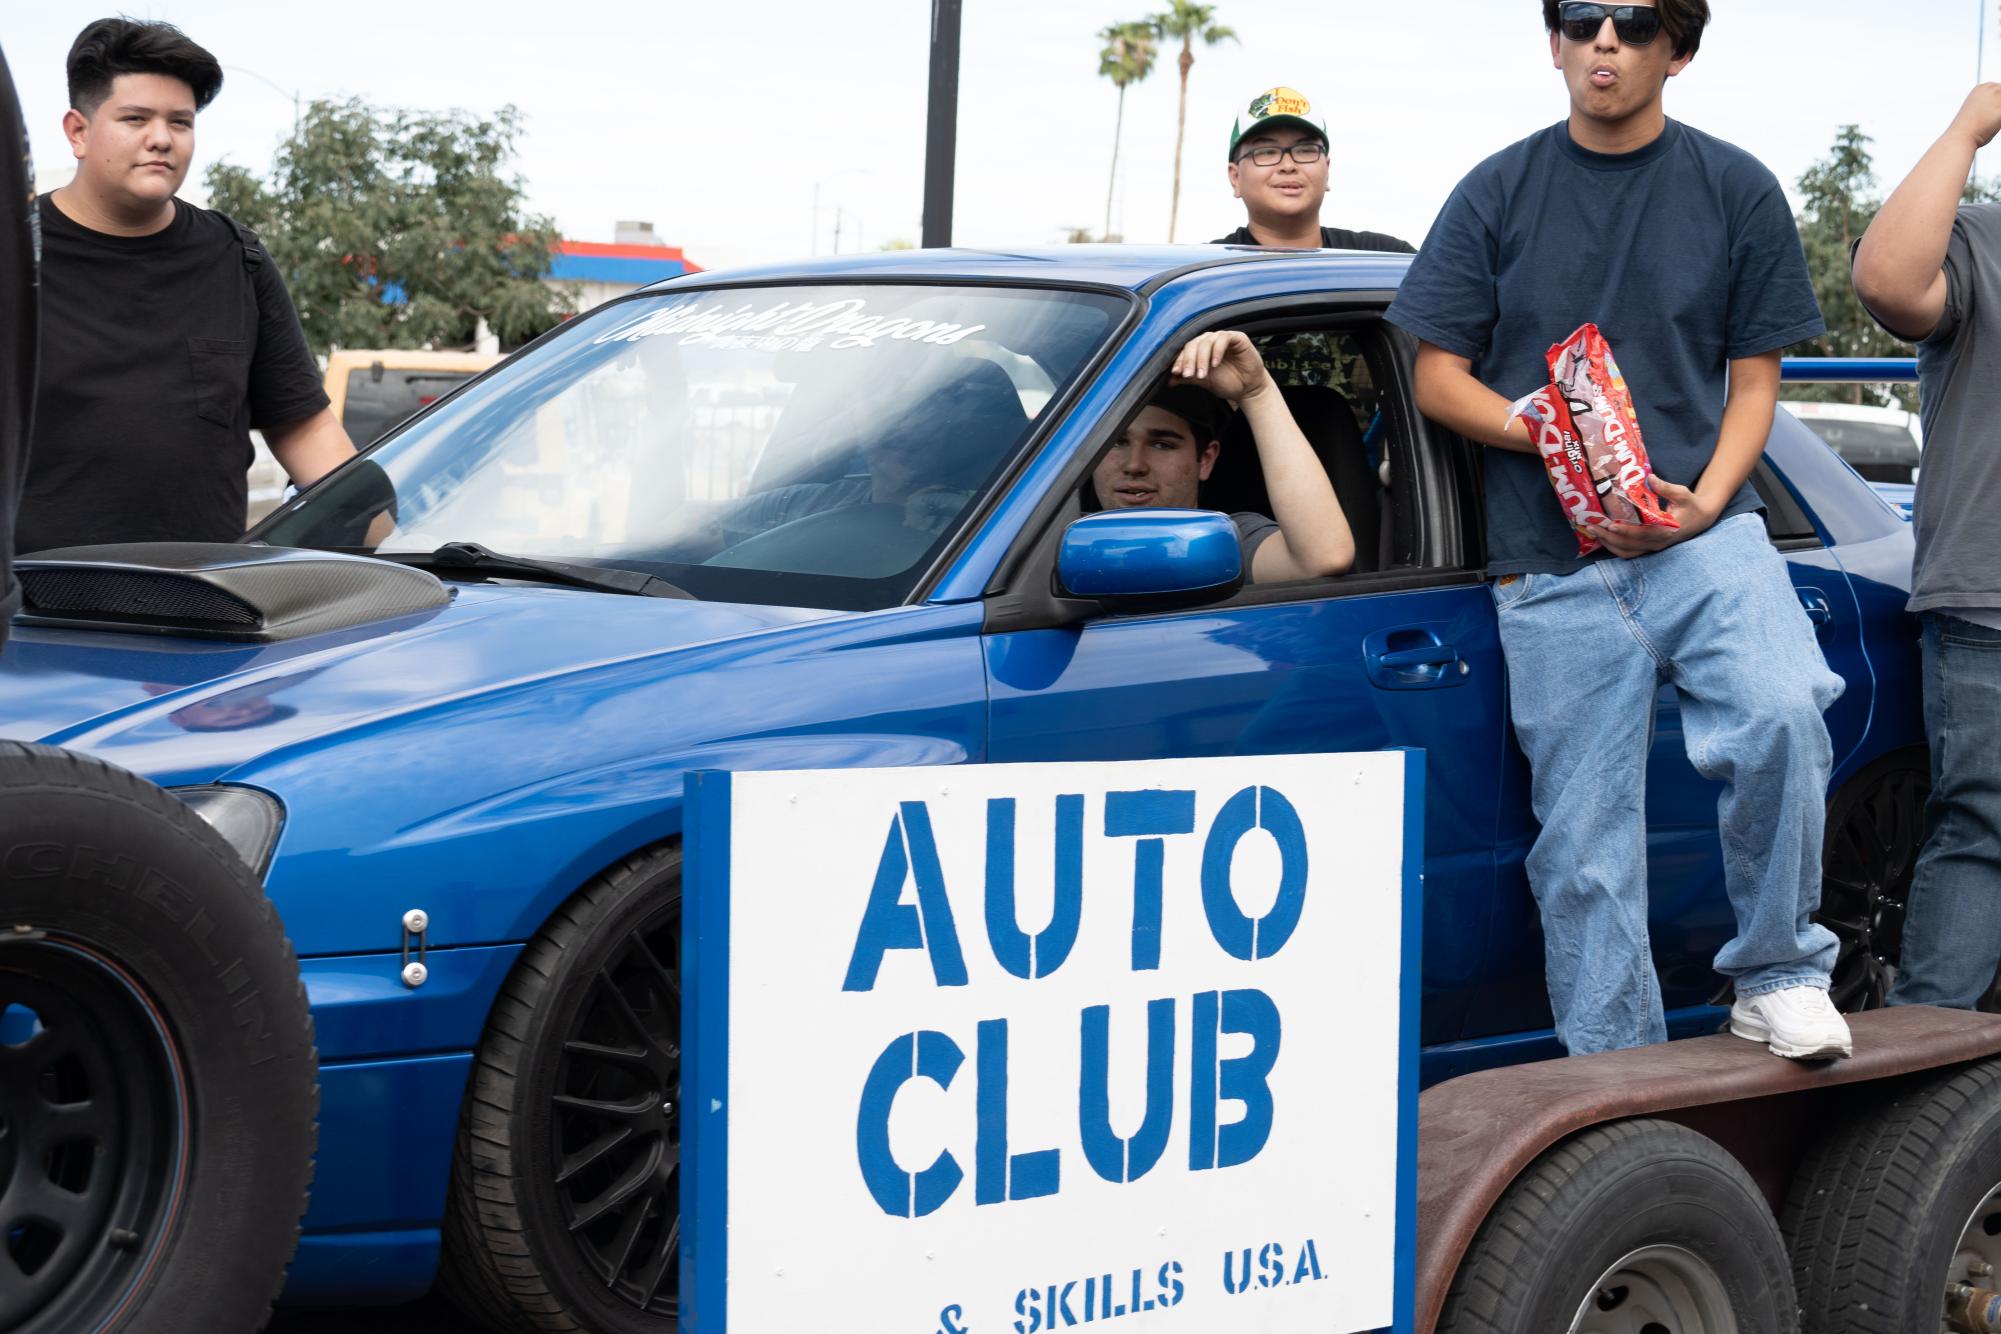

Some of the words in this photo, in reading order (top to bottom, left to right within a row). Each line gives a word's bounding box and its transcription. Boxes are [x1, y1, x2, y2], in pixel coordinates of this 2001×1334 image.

[1275, 96, 1308, 108] Don't
[1277, 105, 1302, 115] Fish
[775, 299, 986, 349] Dragons
[842, 785, 1309, 993] AUTO
[856, 988, 1282, 1218] CLUB
[936, 1304, 968, 1334] &
[1014, 1261, 1184, 1334] SKILLS
[1223, 1239, 1329, 1294] U.S.A.
